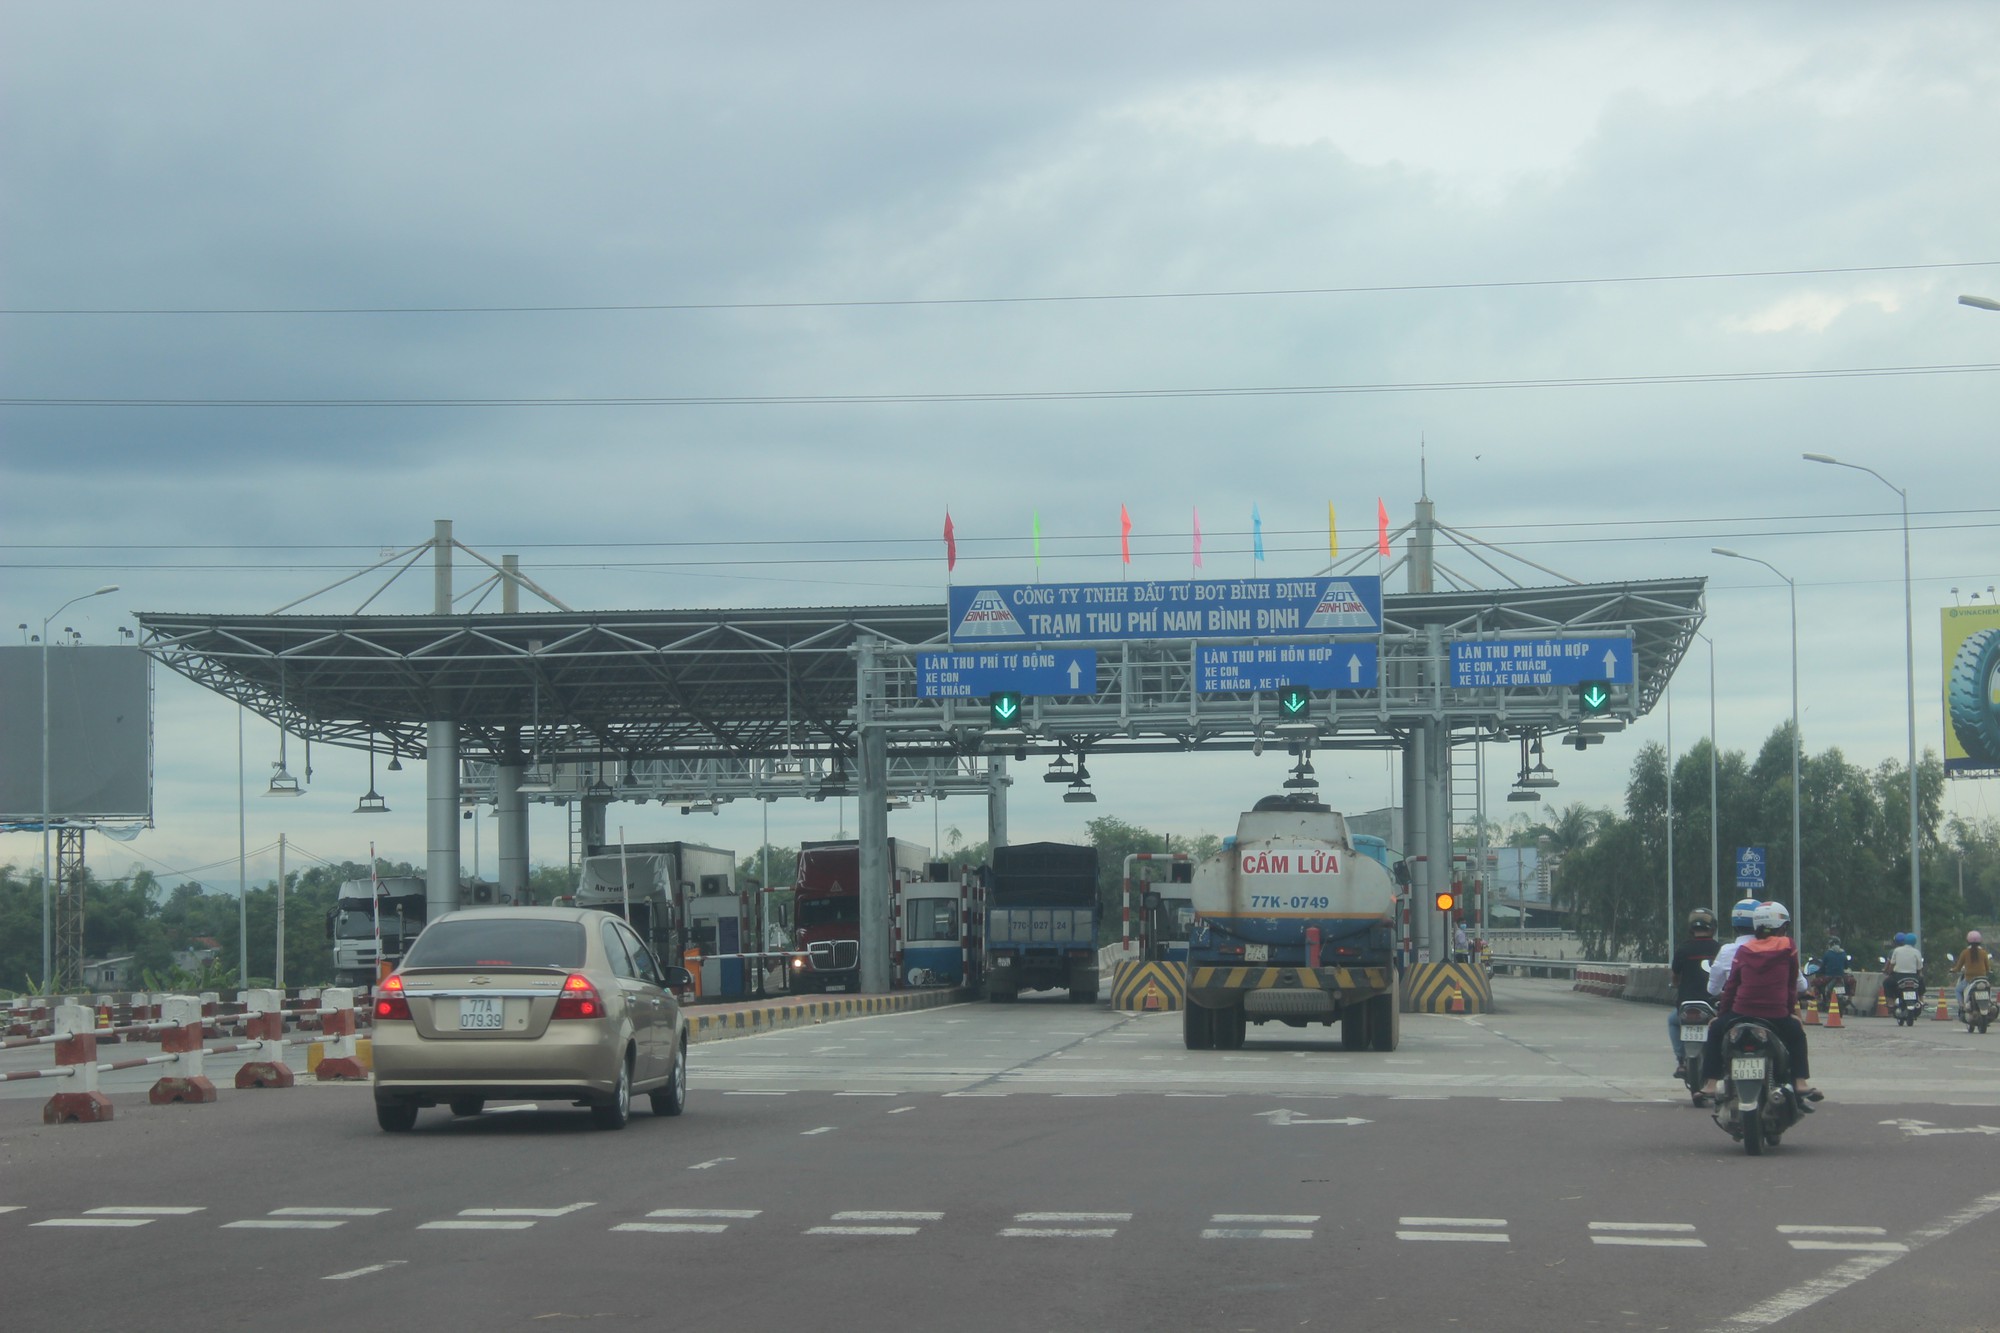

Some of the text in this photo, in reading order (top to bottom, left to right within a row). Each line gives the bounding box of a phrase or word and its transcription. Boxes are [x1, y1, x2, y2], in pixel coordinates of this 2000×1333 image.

[1013, 580, 1316, 604] CÔNG TY TNHH ĐẦU TƯ BOT BÌNH ĐỊNH
[1324, 592, 1356, 602] BOT
[971, 600, 1004, 610] BOT
[1029, 606, 1299, 638] TRẠM THU PHÍ NAM BÌNH ĐỊNH
[1204, 645, 1332, 664] LÀN THU PHÍ HỖN HỢP
[1458, 640, 1589, 659] LÀN THU PHÍ HỖN HỢP
[925, 652, 1054, 671] LÀN THU PHÍ TỰ ĐỘNG
[1459, 662, 1471, 672] XE
[1501, 661, 1512, 671] XE
[1516, 658, 1546, 671] KHÁCH
[926, 672, 958, 682] XE CON
[1205, 667, 1238, 677] XE CON
[1460, 675, 1471, 685] XE
[1512, 672, 1530, 685] QUÁ
[926, 683, 970, 695] XE KHÁCH
[1205, 680, 1217, 690] XE
[1260, 679, 1271, 688] XE
[1243, 850, 1339, 873] CẤM LỬA
[471, 1000, 493, 1011] 77A
[461, 1014, 501, 1027] 079.39
